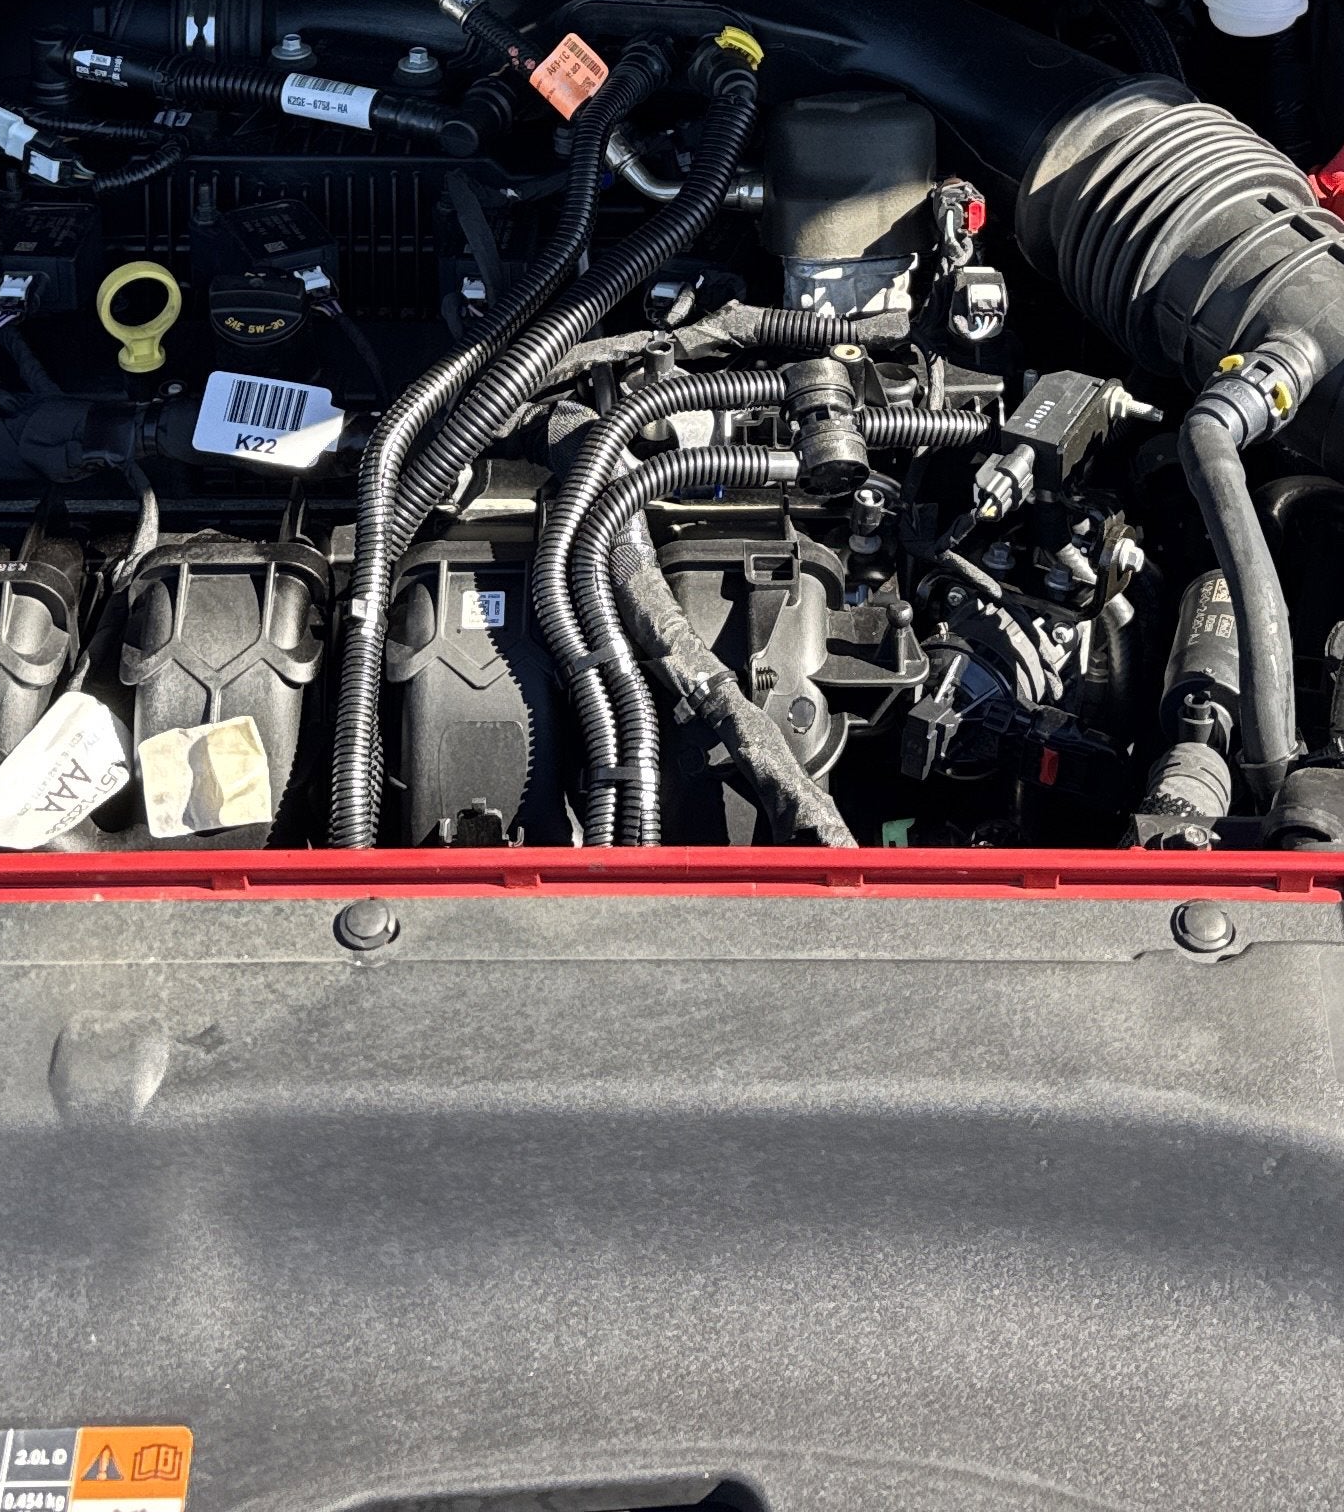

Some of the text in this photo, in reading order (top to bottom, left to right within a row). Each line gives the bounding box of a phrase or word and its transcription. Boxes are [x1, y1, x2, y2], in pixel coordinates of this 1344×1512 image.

[224, 316, 286, 334] SAE 5W-30
[235, 433, 277, 455] K22
[35, 758, 92, 812] AAA
[14, 1448, 50, 1466] 2.0L
